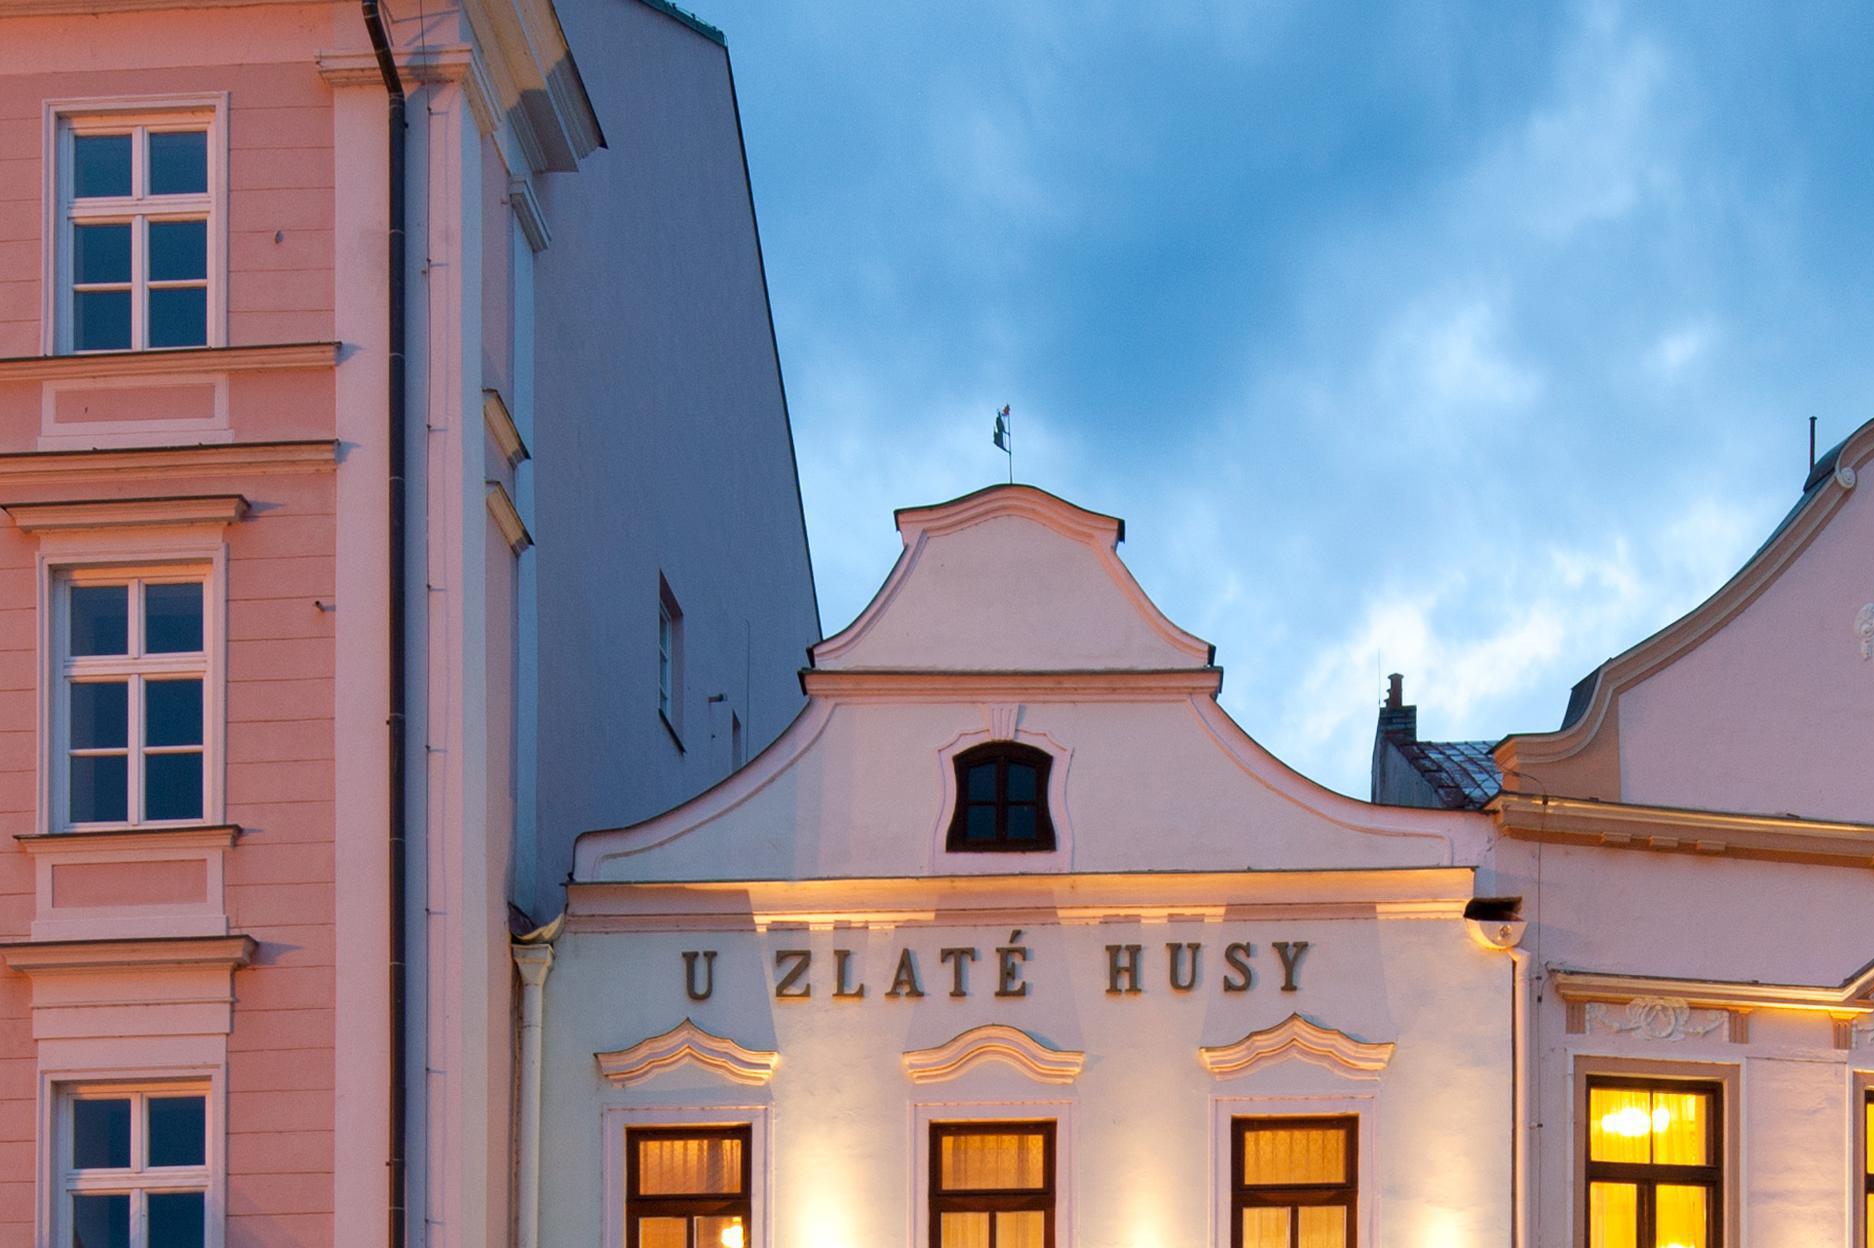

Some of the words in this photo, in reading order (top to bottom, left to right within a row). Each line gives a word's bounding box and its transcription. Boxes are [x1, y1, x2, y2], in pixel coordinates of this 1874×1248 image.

[681, 950, 718, 1000] U
[774, 929, 1028, 998] ZLATÉ
[1104, 940, 1309, 995] HUSY
